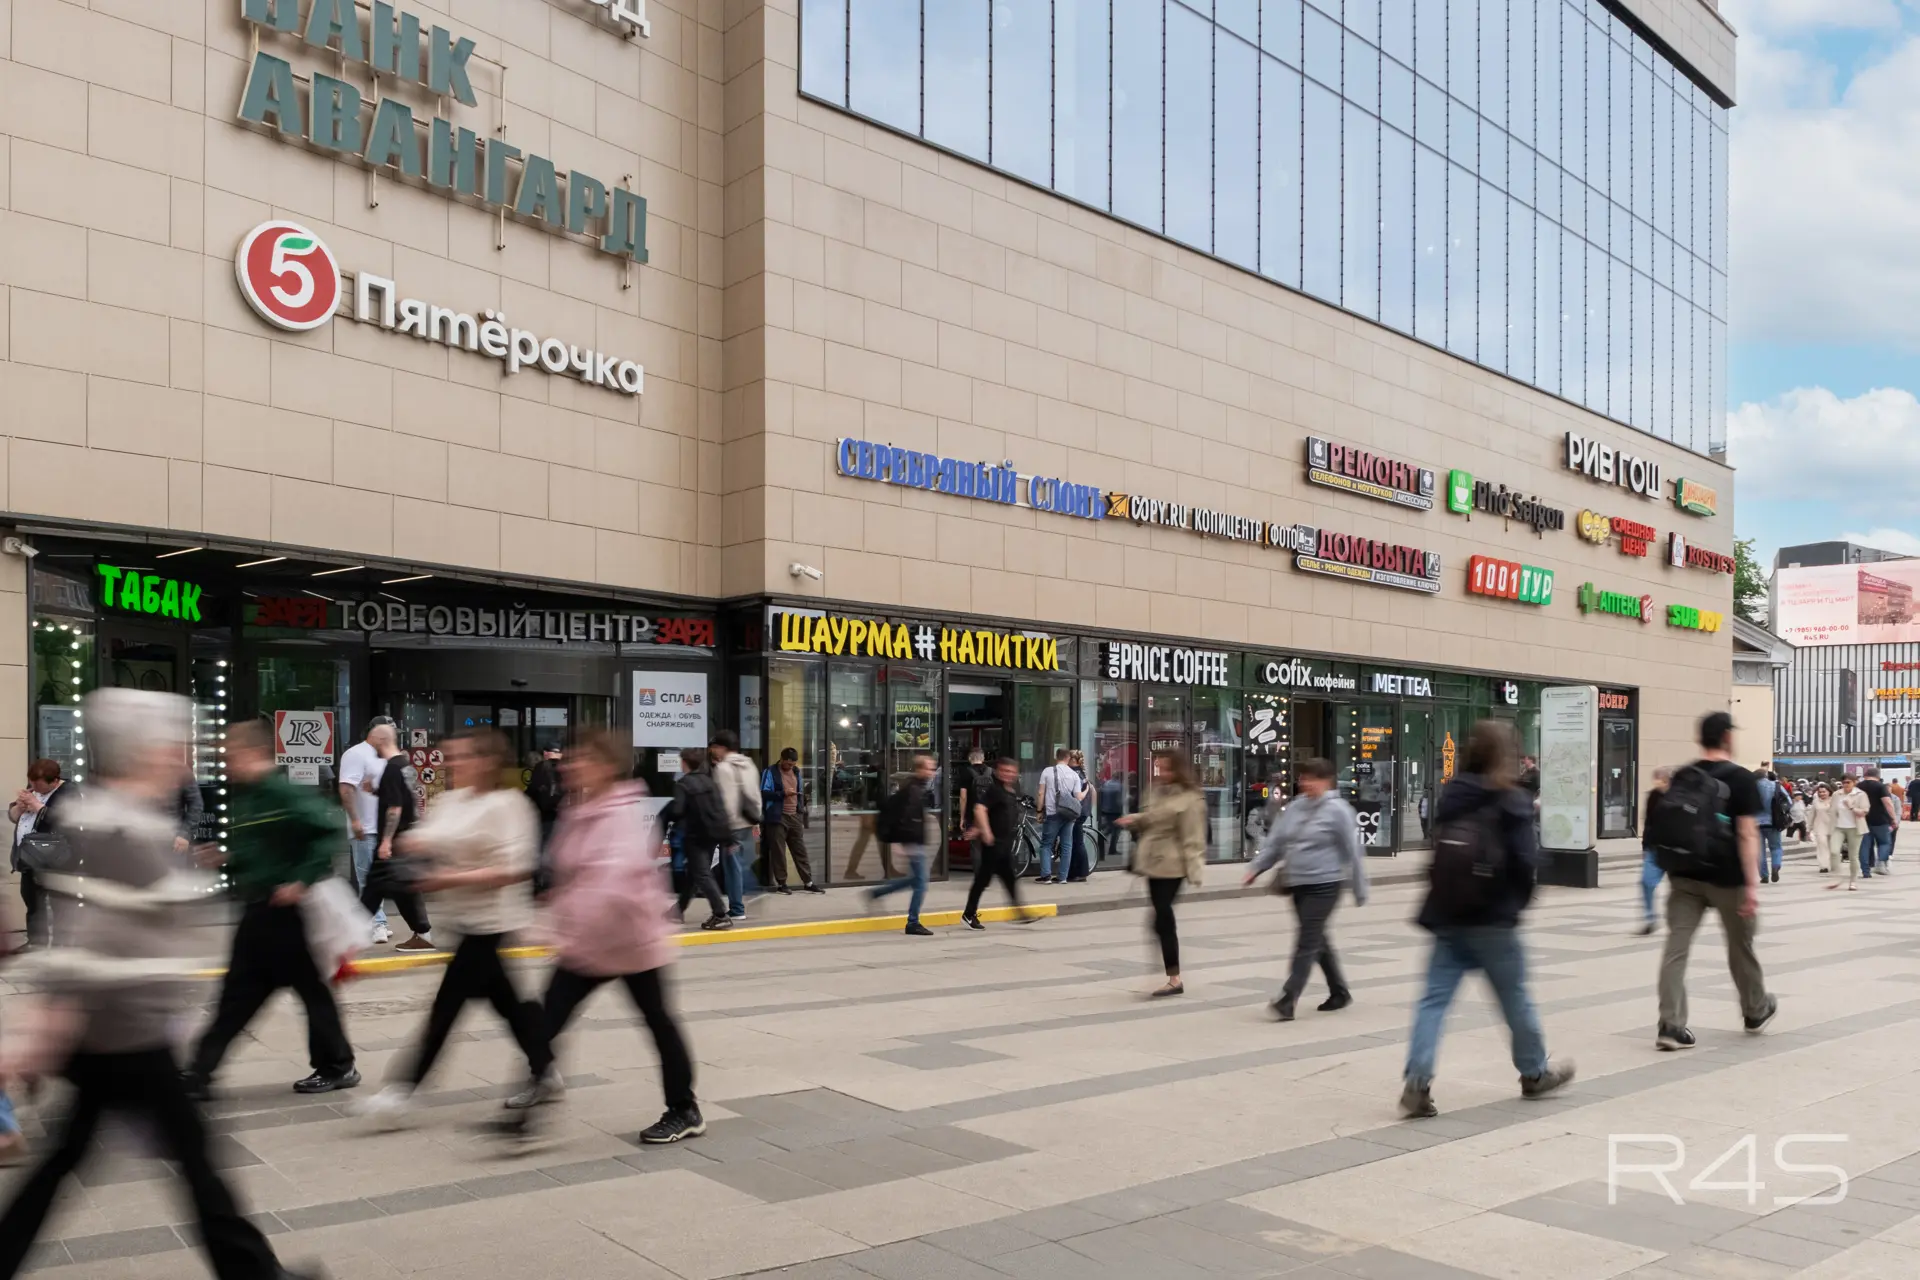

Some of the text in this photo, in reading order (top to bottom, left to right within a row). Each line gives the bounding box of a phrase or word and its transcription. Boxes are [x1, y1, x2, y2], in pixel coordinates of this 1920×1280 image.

[238, 51, 648, 263] АВАНГАРД
[354, 272, 644, 395] Пятёрочка
[837, 437, 1106, 520] СЕРЕБРЯНЫЙ СЛОНЪ
[1329, 442, 1417, 492] РЕМОНТ
[1311, 471, 1351, 488] ТЕЛЕФОНОВ
[1357, 483, 1393, 499] НОУТБУКОВ
[1131, 495, 1187, 528] COPY.RU
[1512, 492, 1564, 532] Saigon
[1193, 507, 1298, 549] КОПИЦЕНТР ФОТО
[1611, 516, 1656, 542] СМЕШНЫЕ
[1318, 528, 1425, 576] ДОМ БЫТА
[1622, 536, 1648, 557] ЦЕНЫ
[1687, 545, 1736, 574] ROSTIC'S
[97, 564, 203, 622] ТАБАК
[1599, 590, 1641, 618] АПТЕКА
[336, 600, 530, 638] ТОРГОВЫЙ
[545, 612, 649, 643] ЦЕНТР
[656, 617, 715, 647] ЗАРЯ
[780, 611, 913, 660] ШАУРМА
[939, 627, 1059, 671] НАПИТКИ
[1109, 642, 1228, 686] ONE PRICE COFFEE
[1313, 673, 1355, 692] кофейня
[1374, 673, 1431, 696] MET TEA
[660, 693, 702, 706] СПЛАВ
[896, 703, 929, 713] ШАУРМА
[639, 711, 702, 720] ОДЕЖДА ОБУВЬ
[646, 721, 695, 729] СНАРЯЖЕНИЕ
[277, 756, 332, 764] ROSTIC'S
